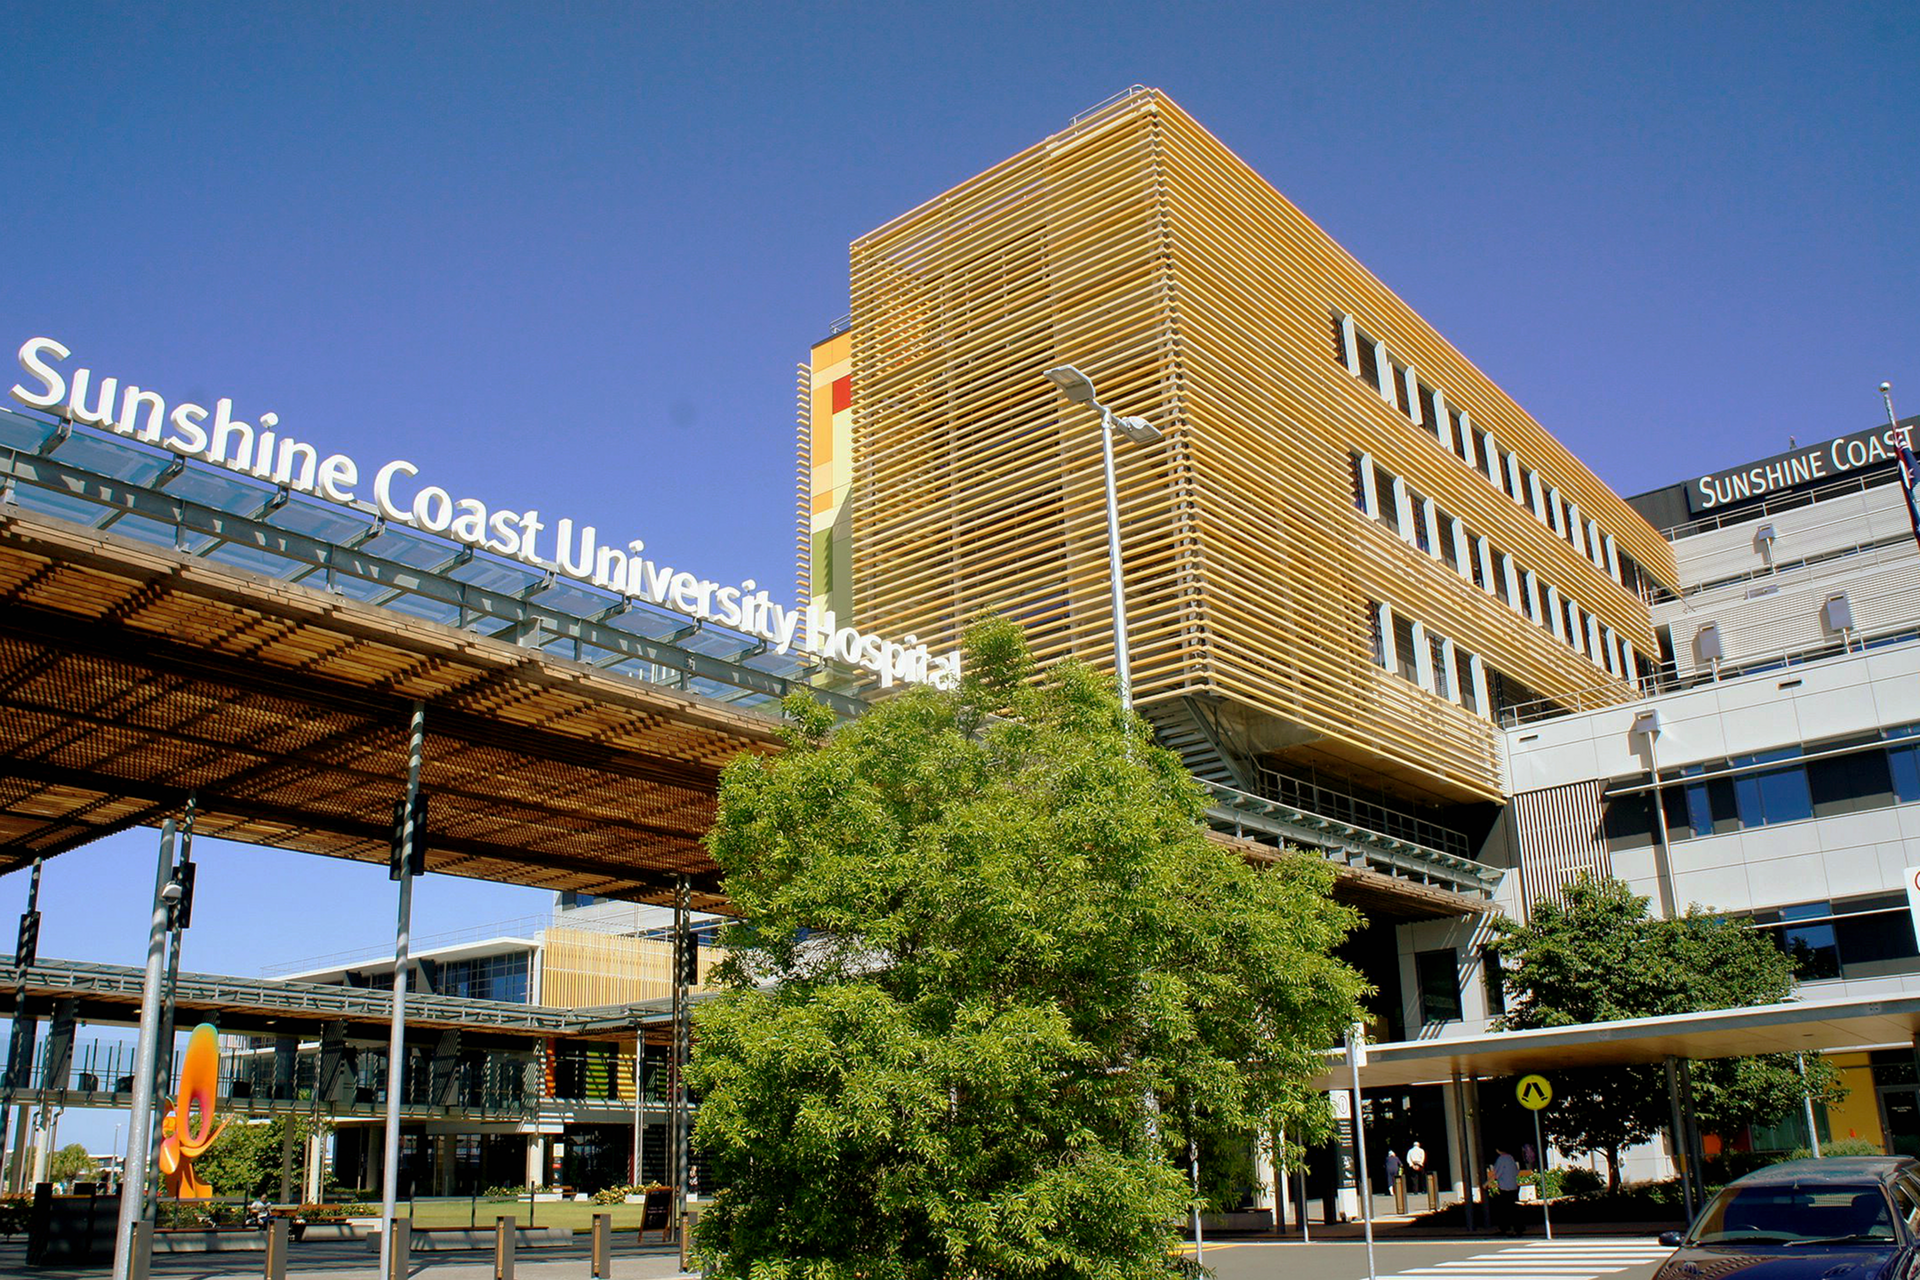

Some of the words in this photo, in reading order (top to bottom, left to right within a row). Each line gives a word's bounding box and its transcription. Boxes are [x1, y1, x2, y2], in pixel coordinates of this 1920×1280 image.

[10, 337, 358, 503] Sunshine
[374, 460, 545, 564] Coast
[556, 517, 798, 654] University
[806, 604, 961, 690] Hospital
[1699, 451, 1826, 508] SUNSHINE
[1831, 425, 1914, 471] COAST
